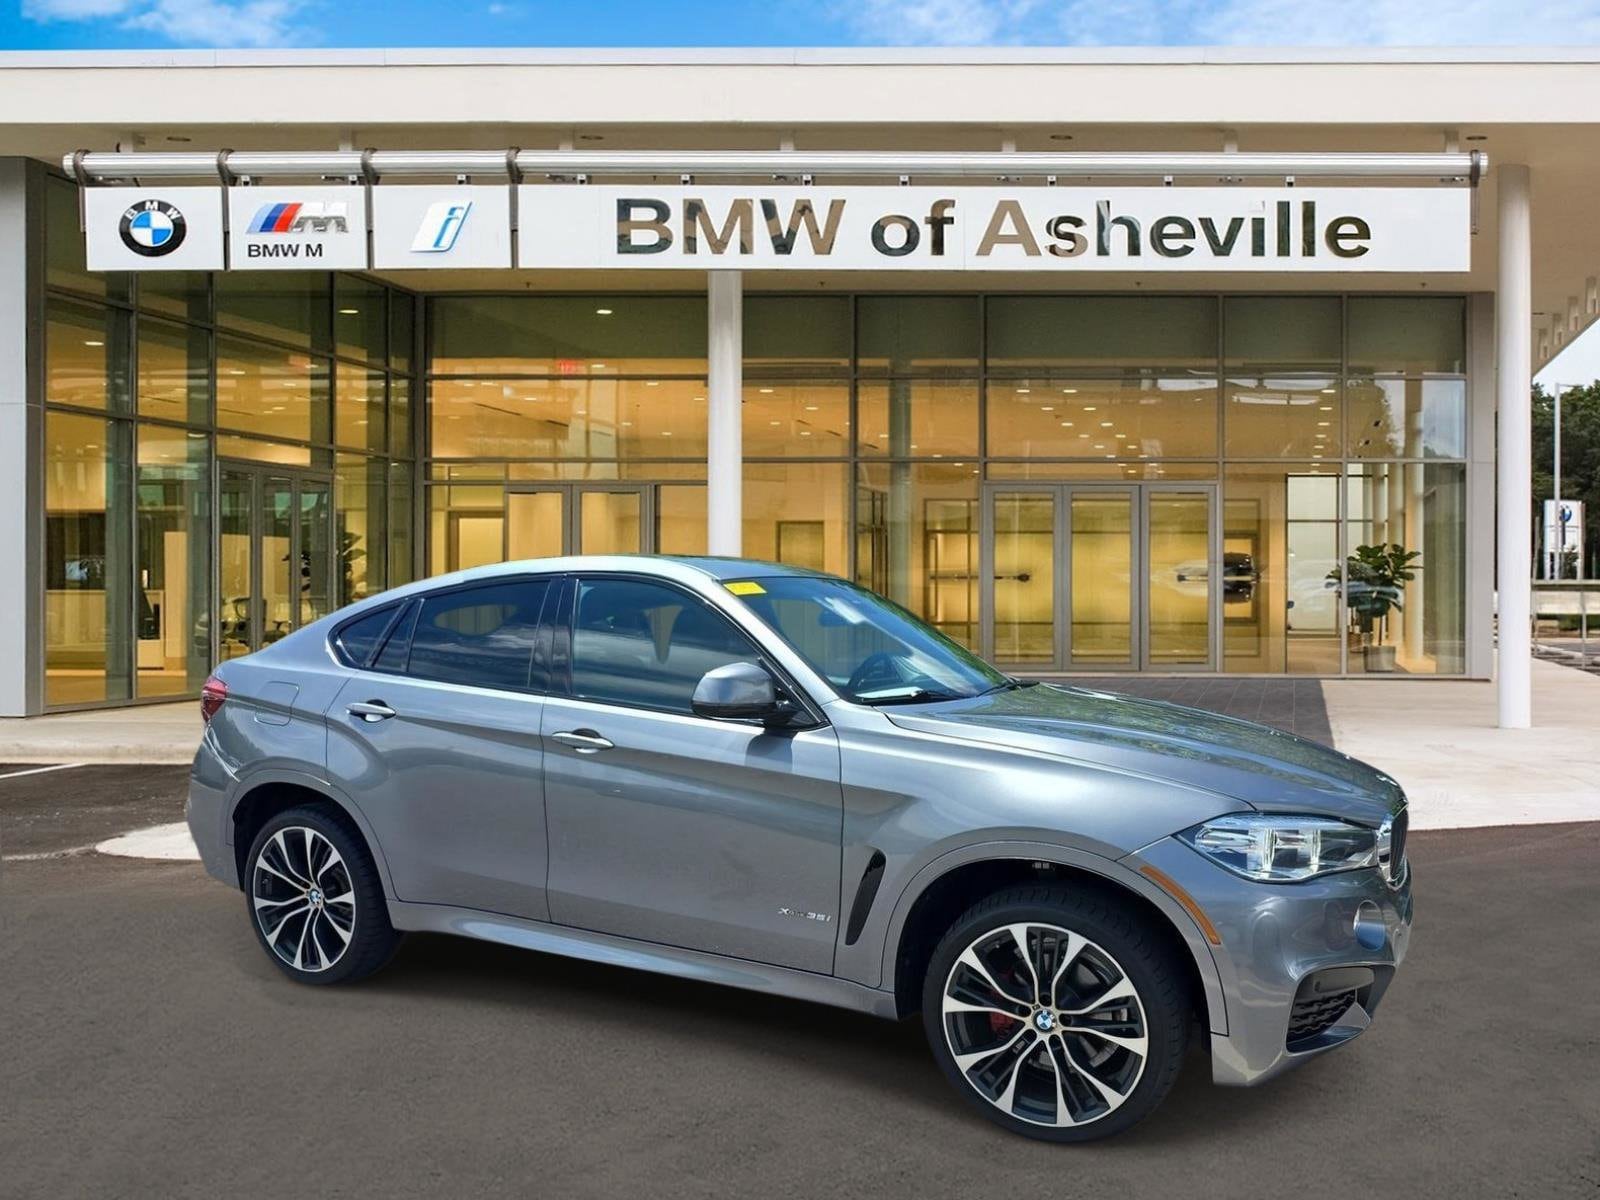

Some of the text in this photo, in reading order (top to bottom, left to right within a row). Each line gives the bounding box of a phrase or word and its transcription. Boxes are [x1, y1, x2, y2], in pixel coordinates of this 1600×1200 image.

[124, 200, 181, 220] BMW
[615, 198, 1372, 258] BMW of Asheville
[247, 243, 323, 257] BMW M
